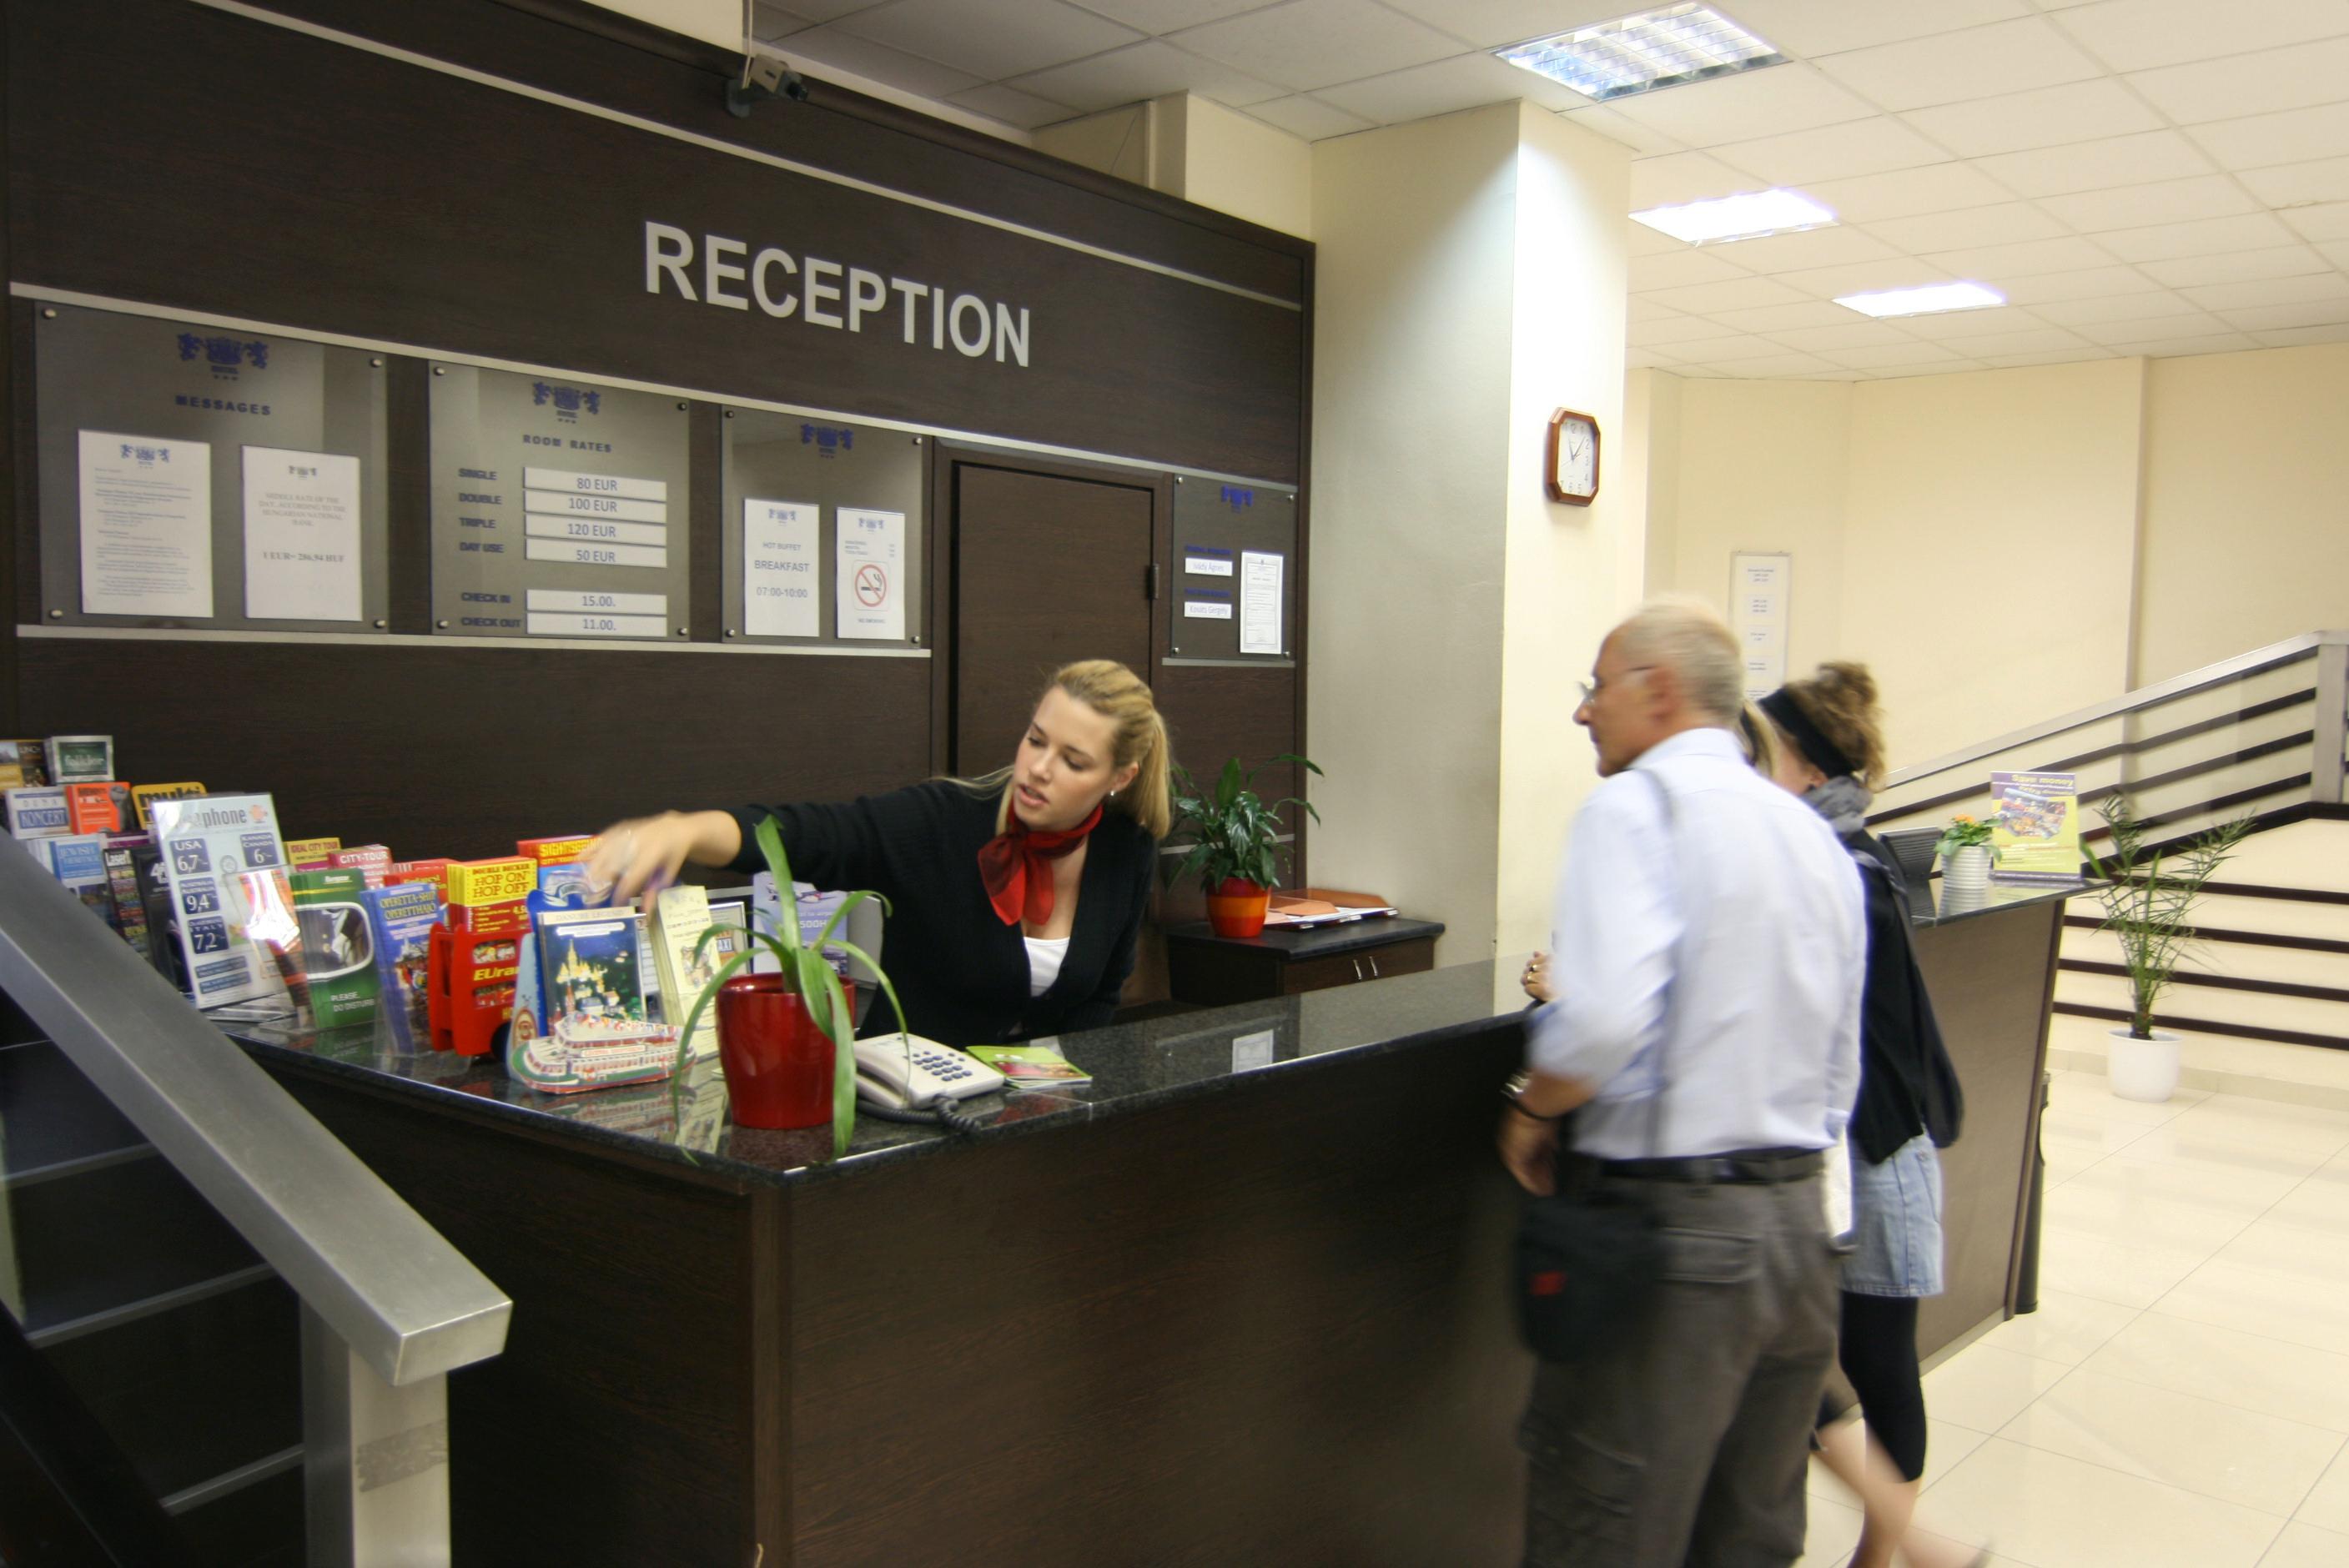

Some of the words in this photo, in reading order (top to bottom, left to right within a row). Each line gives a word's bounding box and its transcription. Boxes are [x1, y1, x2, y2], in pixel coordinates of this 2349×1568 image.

[646, 221, 1029, 367] RECEPTION
[175, 395, 271, 415] MESSAGES
[523, 435, 561, 447] ROOM
[570, 440, 611, 453] RATES
[459, 468, 497, 480] SINGLE
[577, 478, 591, 490] 80
[594, 480, 617, 491] EUR
[460, 493, 502, 505] DOUBLE
[569, 498, 590, 510] 100
[594, 500, 617, 512] EUR
[460, 517, 495, 529] TRIPLE
[568, 524, 589, 535] 120
[592, 525, 616, 538] EUR
[460, 542, 480, 552] DAY
[483, 544, 504, 553] USE
[576, 550, 590, 561] 50
[593, 551, 616, 562] EUR
[754, 560, 810, 572] BREAKFAST
[461, 592, 497, 603] CHECK
[499, 595, 511, 604] IN
[756, 586, 807, 598] 07:00-10:00
[581, 596, 616, 607] 15.00.
[461, 617, 497, 627] CHECK
[499, 619, 521, 628] OUT
[583, 620, 616, 631] 11.00.
[21, 809, 67, 827] KONCERT
[174, 841, 202, 851] USA
[502, 863, 530, 872] DECKER
[475, 874, 503, 887] HOP
[473, 885, 500, 898] HOP
[504, 881, 529, 894] OFF
